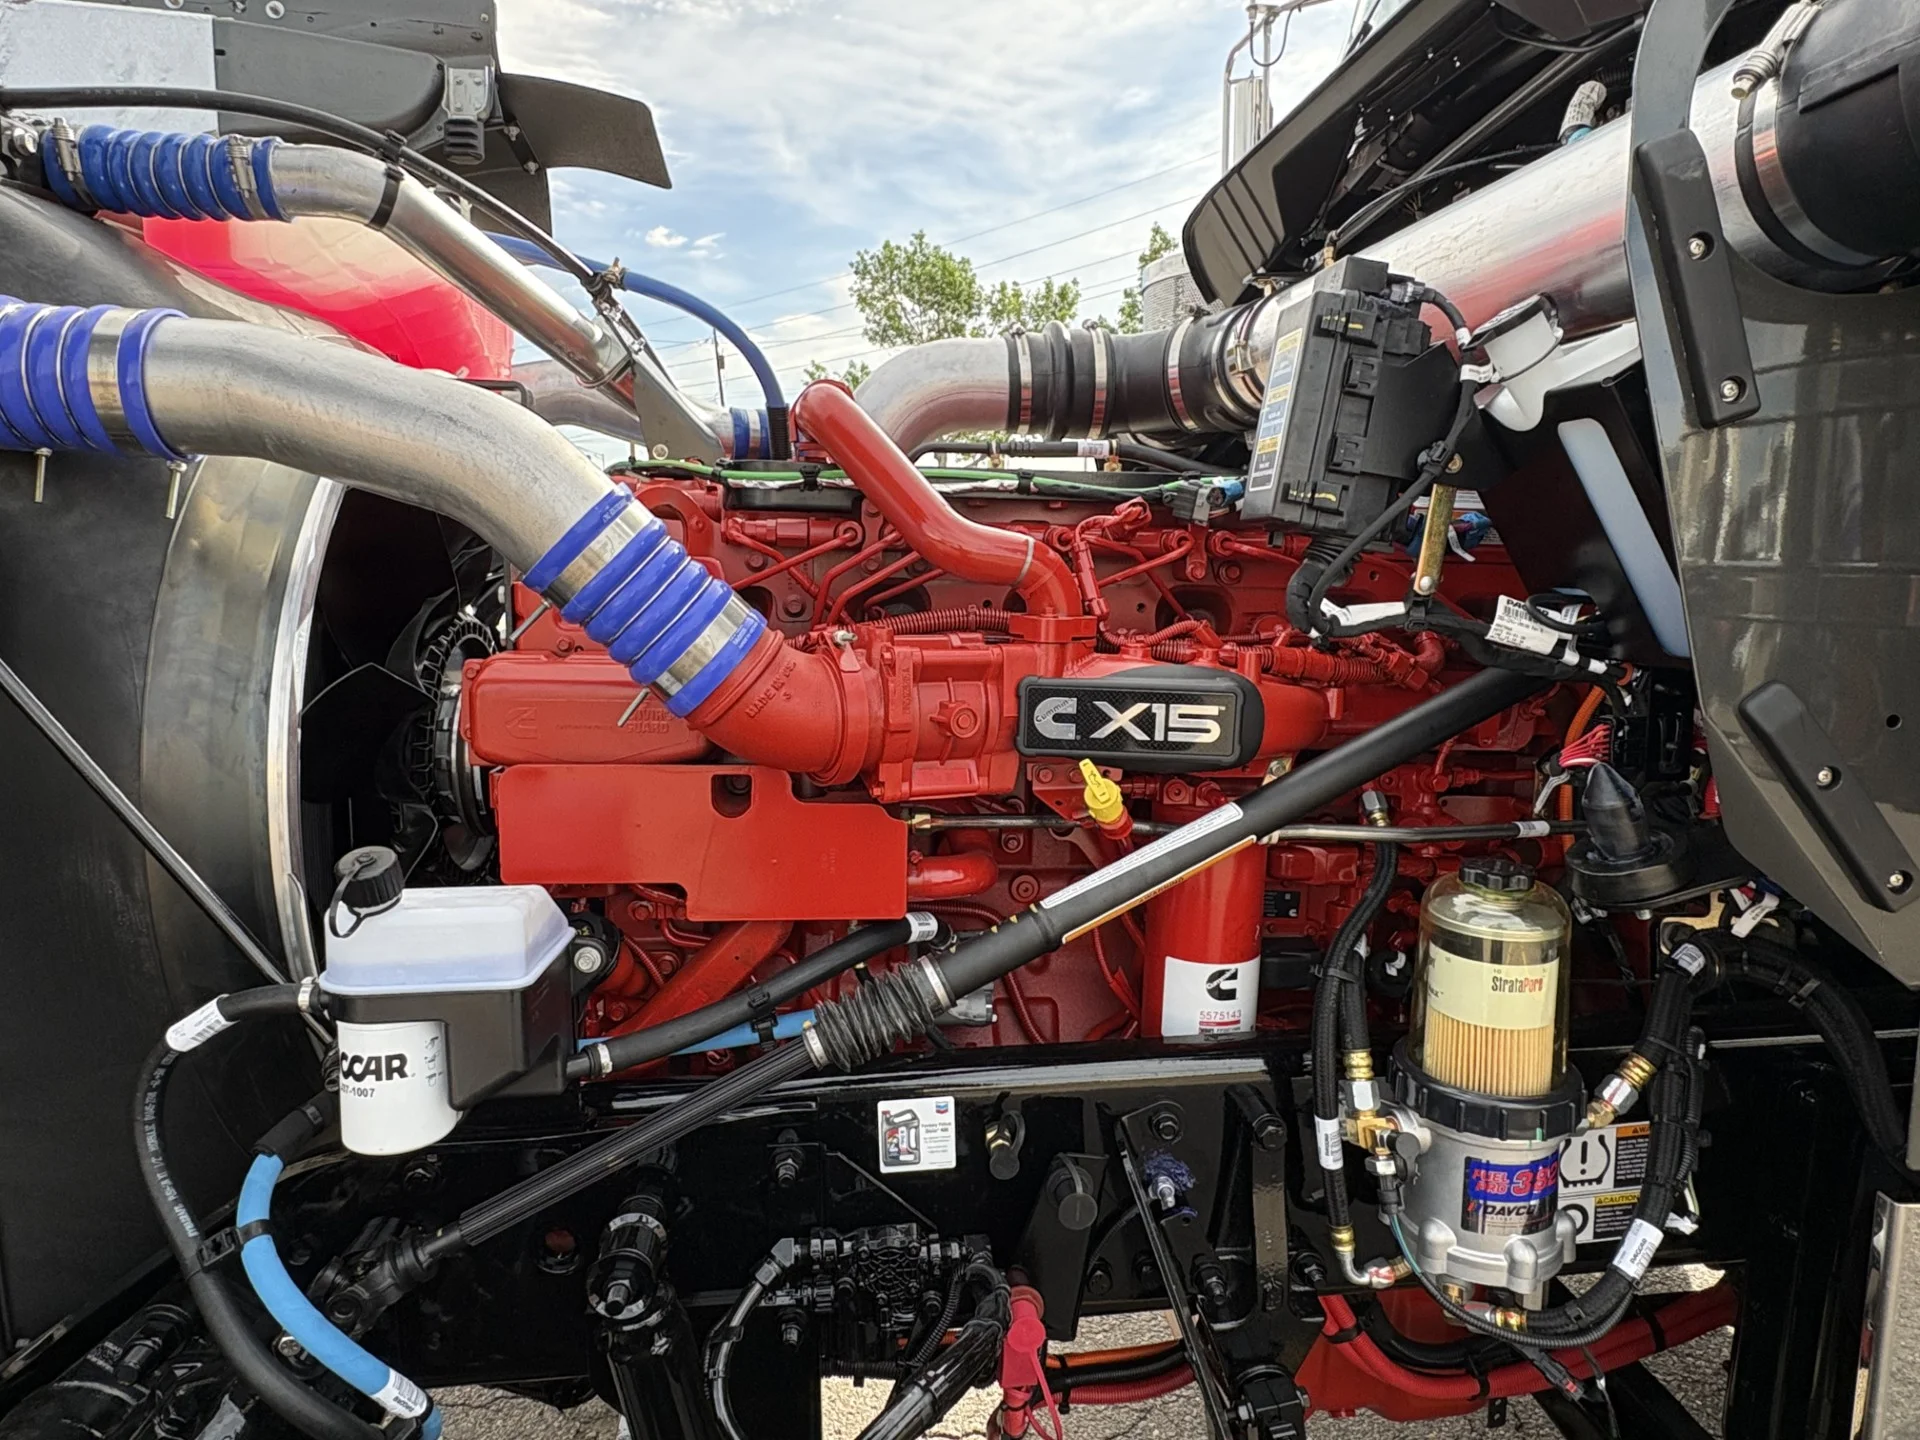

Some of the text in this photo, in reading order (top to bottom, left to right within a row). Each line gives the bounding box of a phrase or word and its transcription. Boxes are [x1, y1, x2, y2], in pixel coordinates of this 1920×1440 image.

[1506, 598, 1550, 618] PACAR
[1089, 701, 1221, 743] X15
[1491, 975, 1543, 993] StrataPore
[1199, 1009, 1242, 1020] 5575143
[340, 1051, 409, 1083] CCAR
[1472, 1168, 1509, 1182] FUEL
[1475, 1180, 1508, 1195] PRO
[1603, 1194, 1638, 1205] CAUTION
